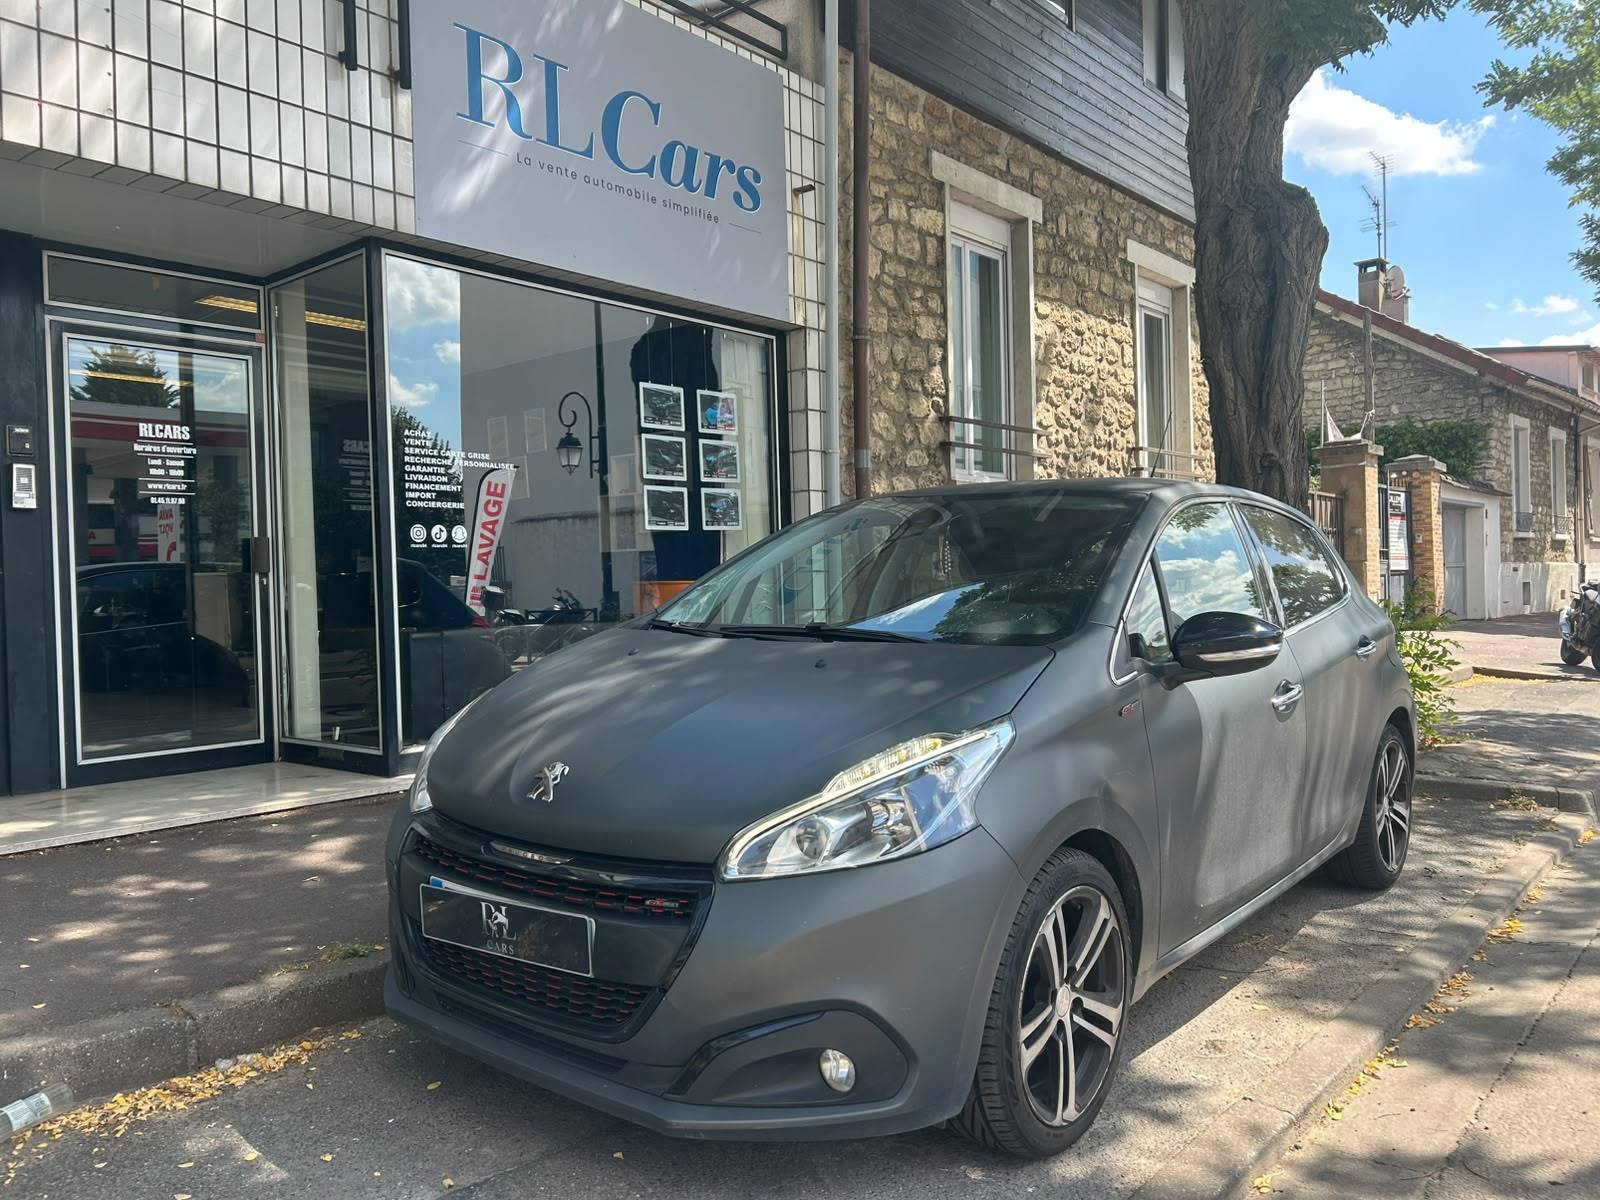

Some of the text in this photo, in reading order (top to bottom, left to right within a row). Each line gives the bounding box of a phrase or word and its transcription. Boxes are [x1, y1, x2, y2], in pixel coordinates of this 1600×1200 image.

[516, 152, 720, 225] La vente automobile simplifiée
[138, 422, 191, 440] RLCARS
[404, 429, 431, 439] ACHAT
[404, 438, 431, 447] VENTE
[404, 447, 490, 460] SERVICE CARTE GRISE
[404, 456, 452, 466] RECHERCHE
[404, 465, 446, 474] GARANTIE
[405, 474, 448, 483] LIVRAISON
[405, 482, 462, 492] FINANCEMENT
[405, 491, 437, 499] IMPORT
[406, 500, 465, 510] CONCIERGERIE
[474, 480, 507, 581] LAVAGE
[486, 939, 515, 956] CARS
